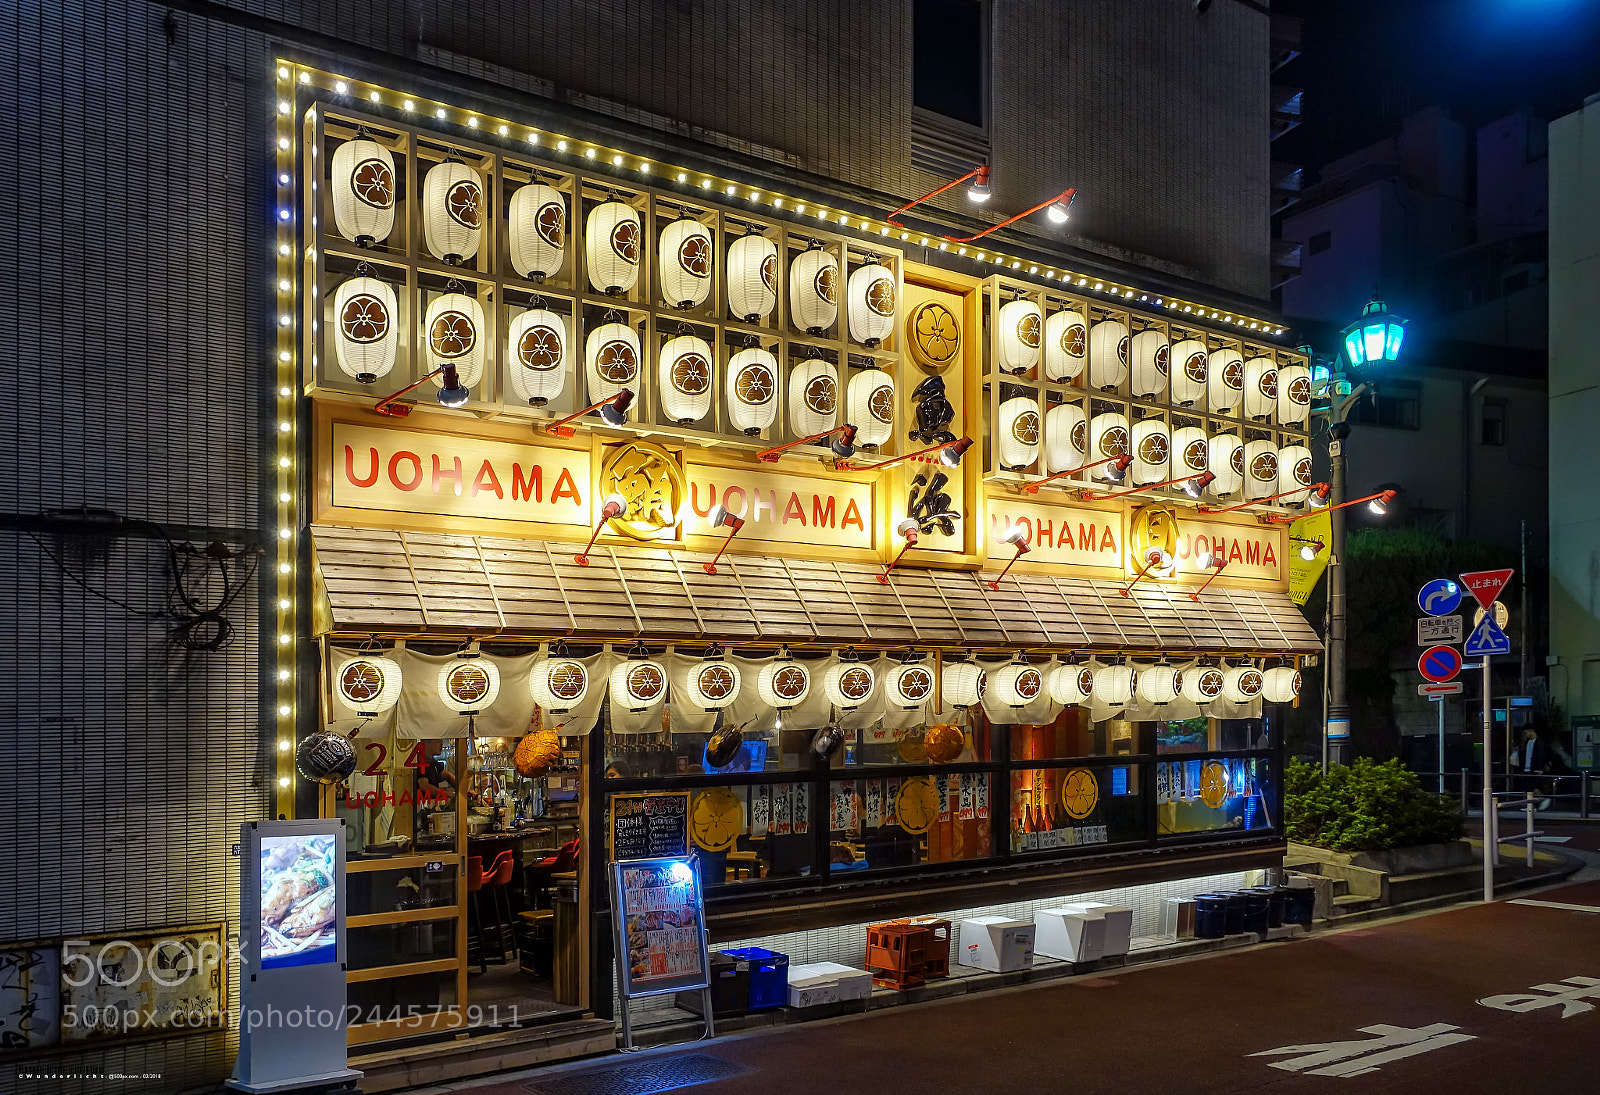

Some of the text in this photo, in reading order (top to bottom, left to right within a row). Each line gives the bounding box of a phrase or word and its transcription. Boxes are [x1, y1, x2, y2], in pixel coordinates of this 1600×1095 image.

[344, 444, 581, 507] UOHAMA
[691, 481, 864, 531] UOHAMA
[1471, 577, 1502, 589] 止まれ
[1420, 627, 1460, 635] 一方通行
[345, 787, 450, 811] UOHAMA
